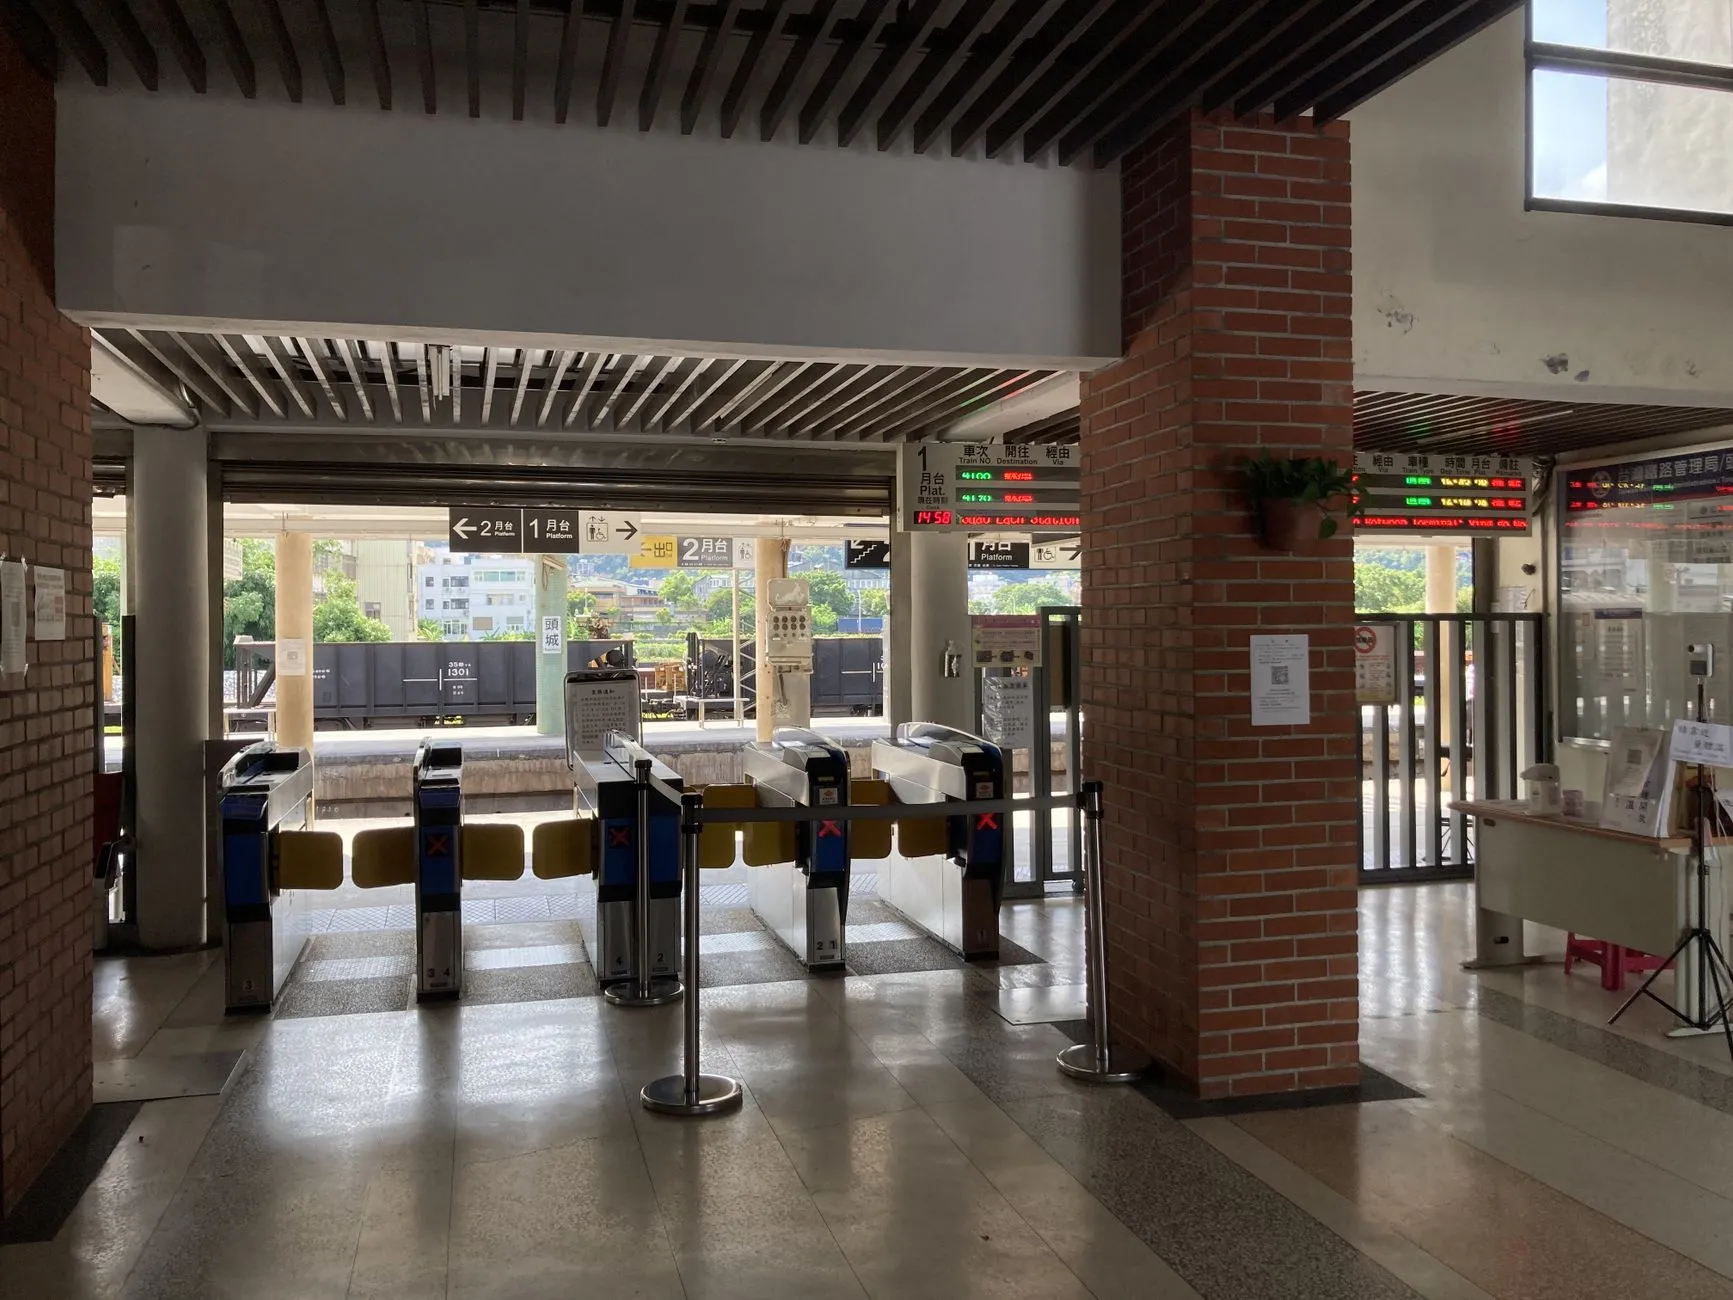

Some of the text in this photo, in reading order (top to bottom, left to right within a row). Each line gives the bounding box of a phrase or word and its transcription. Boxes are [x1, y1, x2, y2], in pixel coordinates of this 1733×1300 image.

[963, 446, 988, 458] 車次
[1005, 446, 1029, 458] 開往
[1046, 447, 1070, 459] 經由
[917, 446, 928, 471] 1
[1472, 458, 1490, 470] 月台
[920, 473, 945, 485] 月台
[919, 485, 945, 496] Plat.
[480, 520, 513, 536] 2 月台
[529, 518, 570, 539] 1 月台
[654, 541, 673, 558] 出口
[682, 538, 727, 560] 2 月台
[981, 553, 1013, 561] Platform
[545, 618, 559, 646] 頭城
[448, 668, 469, 676] 1301
[816, 940, 824, 950] 2
[657, 952, 664, 962] 2
[428, 968, 435, 978] 3
